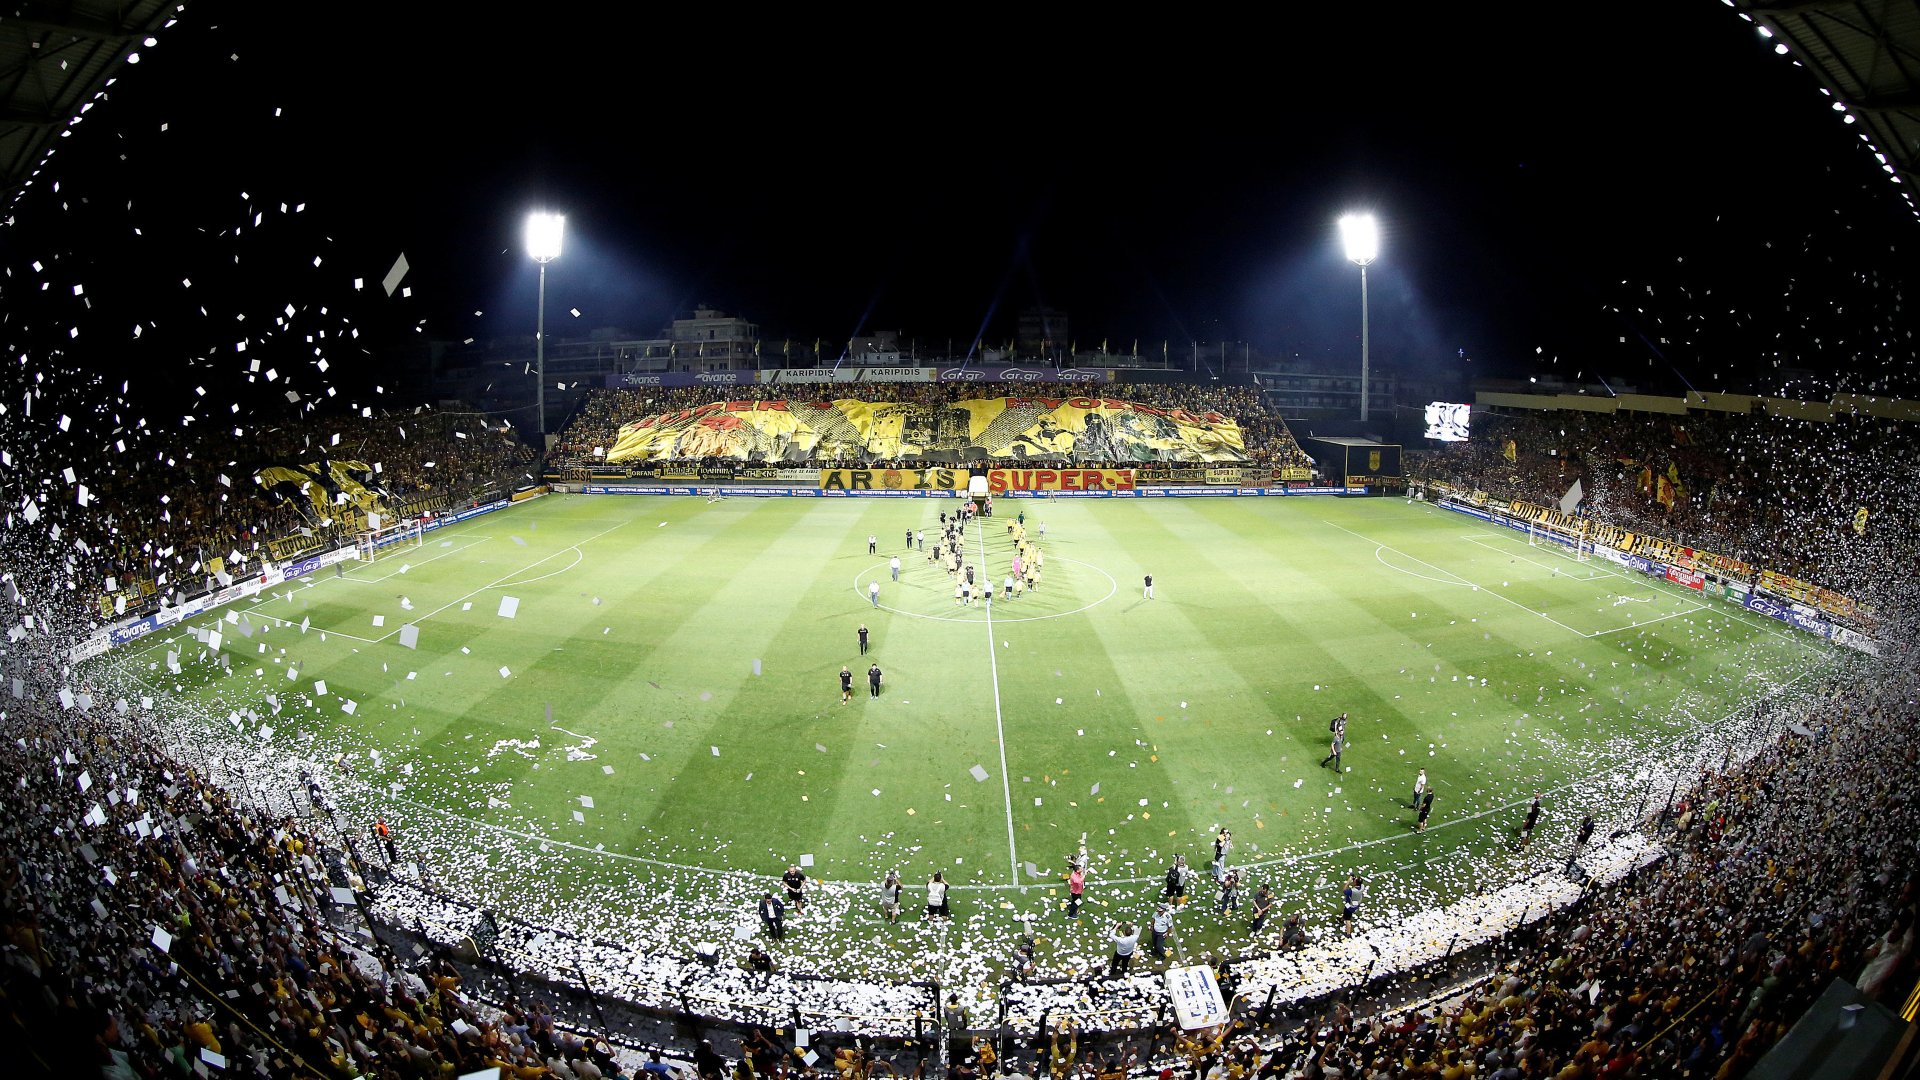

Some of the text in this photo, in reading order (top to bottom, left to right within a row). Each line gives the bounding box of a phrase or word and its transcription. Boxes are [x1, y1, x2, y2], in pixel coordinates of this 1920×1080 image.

[702, 372, 736, 382] avance
[786, 369, 833, 377] KARIPIDIS
[871, 368, 921, 376] KARIPIDIS
[560, 469, 592, 482] EDESSA
[122, 620, 151, 638] avance
[1799, 617, 1827, 632] avance
